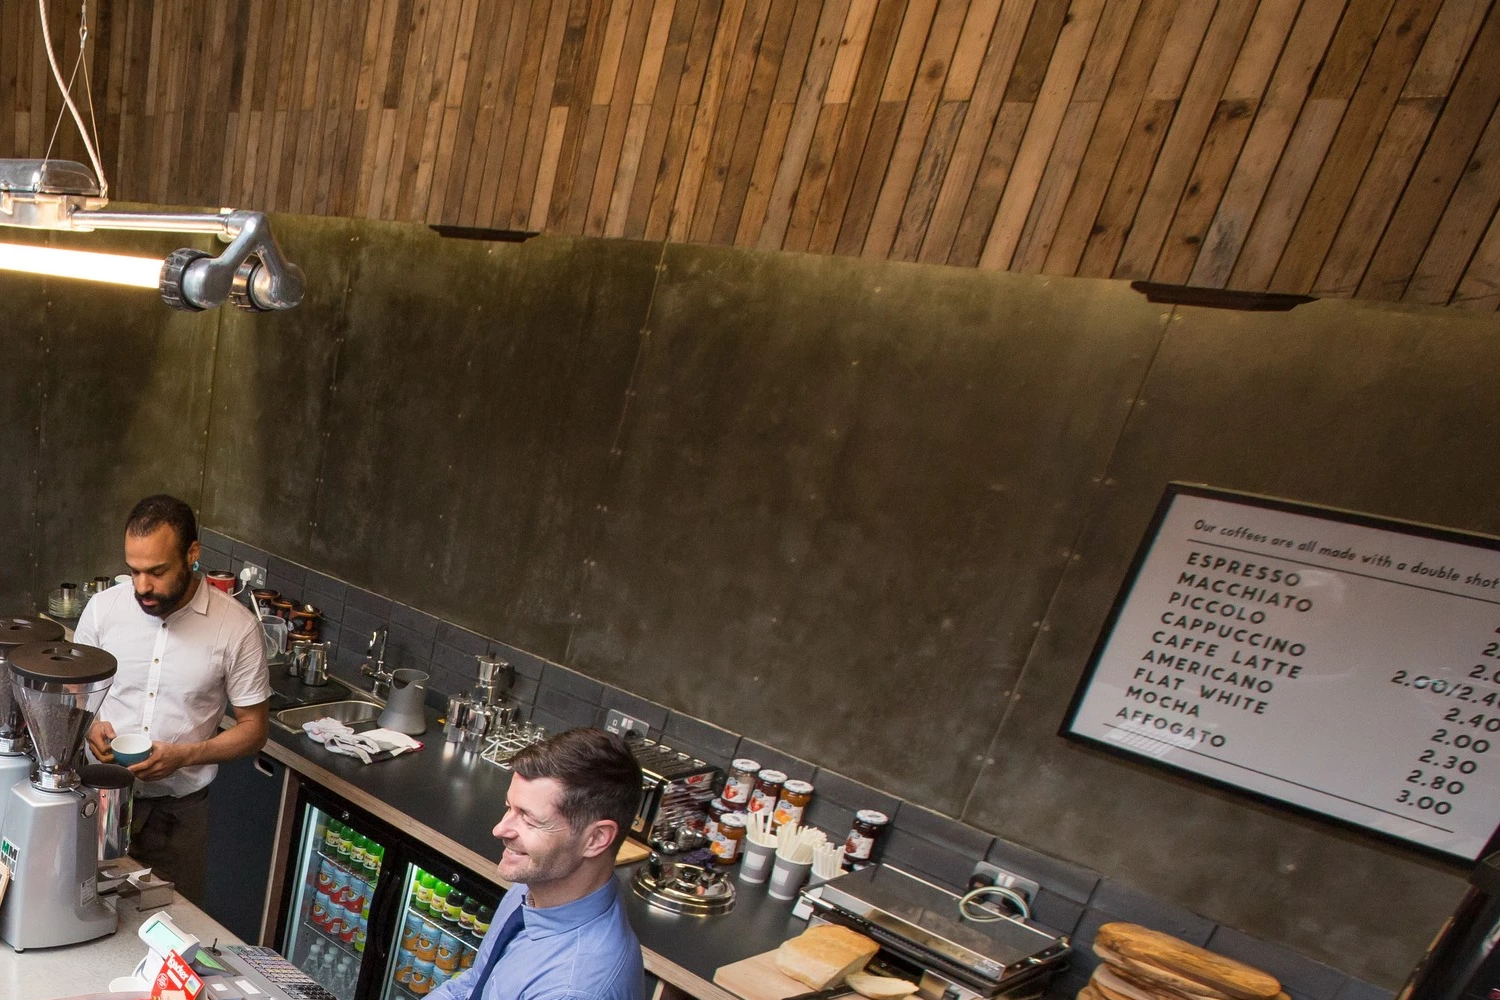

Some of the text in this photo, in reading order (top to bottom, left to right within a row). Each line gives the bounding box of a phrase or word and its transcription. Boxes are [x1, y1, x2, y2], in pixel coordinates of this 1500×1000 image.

[1177, 572, 1314, 613] MACCHIATO
[1186, 552, 1301, 587] ESPRESSO
[1194, 519, 1500, 590] Our coffees are all made with a double shot
[1168, 591, 1266, 624] PICCOLO
[1141, 650, 1490, 754] AMERICANO 2.00
[1152, 631, 1500, 733] CAFFE LATTE 2.40
[1160, 611, 1500, 710] CAPPUCCINO 2.00/2.4
[1116, 706, 1452, 815] AFFOGATO 3.00
[1125, 685, 1465, 795] MOCHA 2.80
[1133, 667, 1477, 775] FLAT WHITE 2.30
